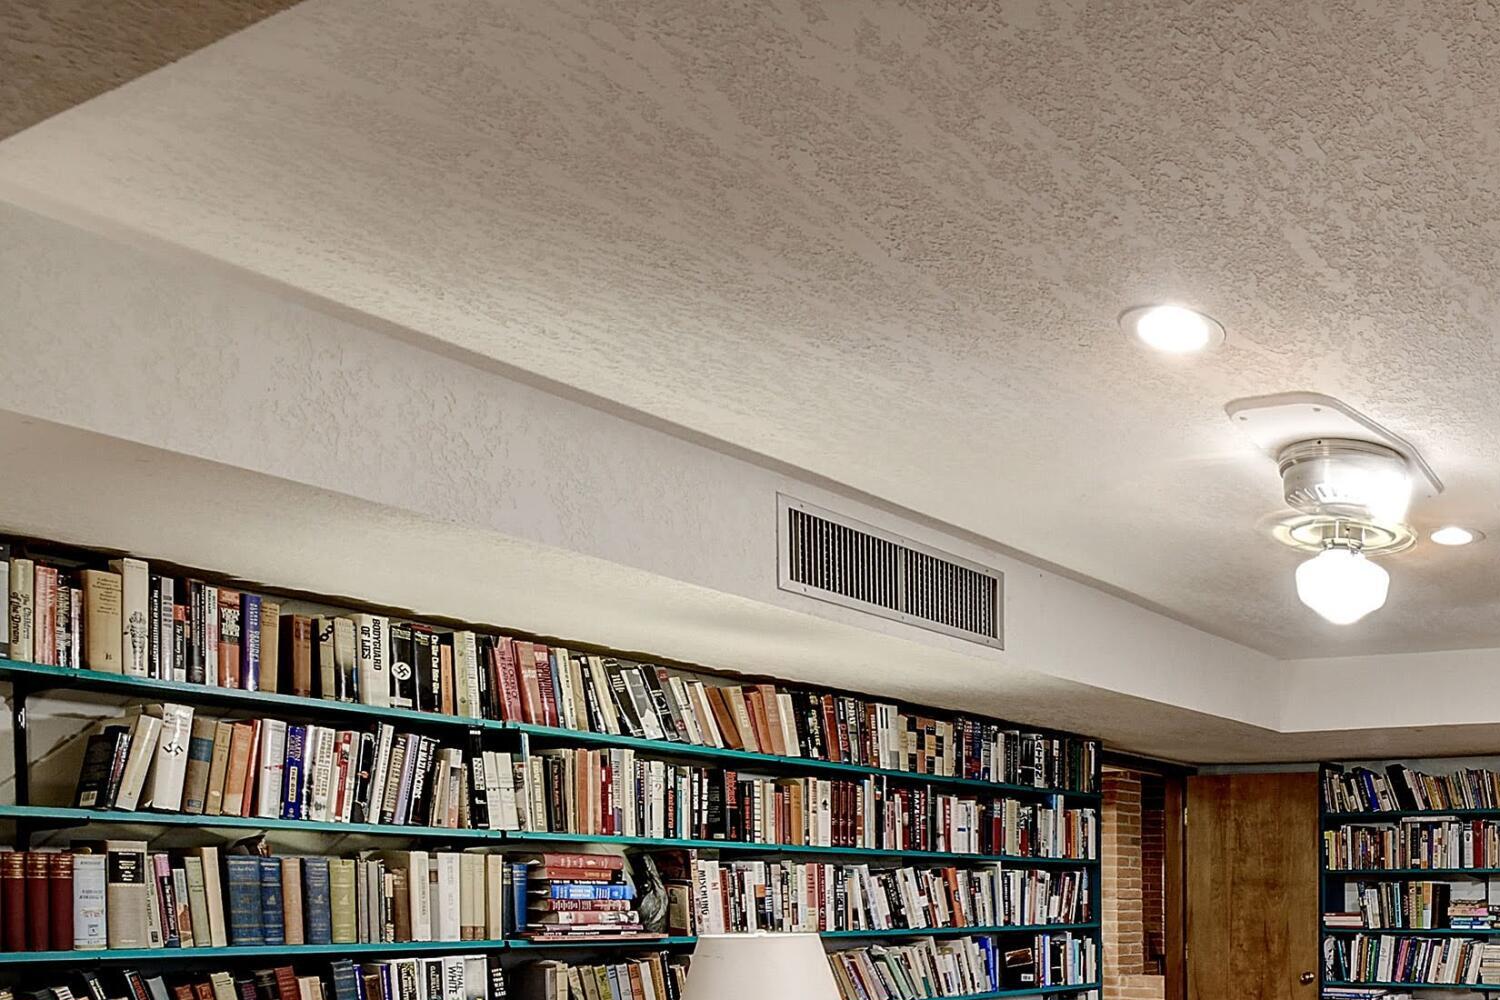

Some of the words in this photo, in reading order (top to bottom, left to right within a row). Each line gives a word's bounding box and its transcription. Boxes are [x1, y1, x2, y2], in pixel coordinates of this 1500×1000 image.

[10, 613, 23, 644] Dream
[21, 606, 32, 639] Children
[361, 626, 370, 639] OF
[361, 639, 371, 660] LIES
[372, 618, 382, 671] BODYGUARD
[839, 723, 849, 751] D-DAY
[418, 750, 427, 767] NAZI
[1035, 734, 1043, 779] PATTON
[414, 768, 425, 798] DOCTORS
[698, 869, 709, 914] MISCHLING
[446, 965, 458, 994] WHITE
[455, 961, 464, 988] LETHAL
